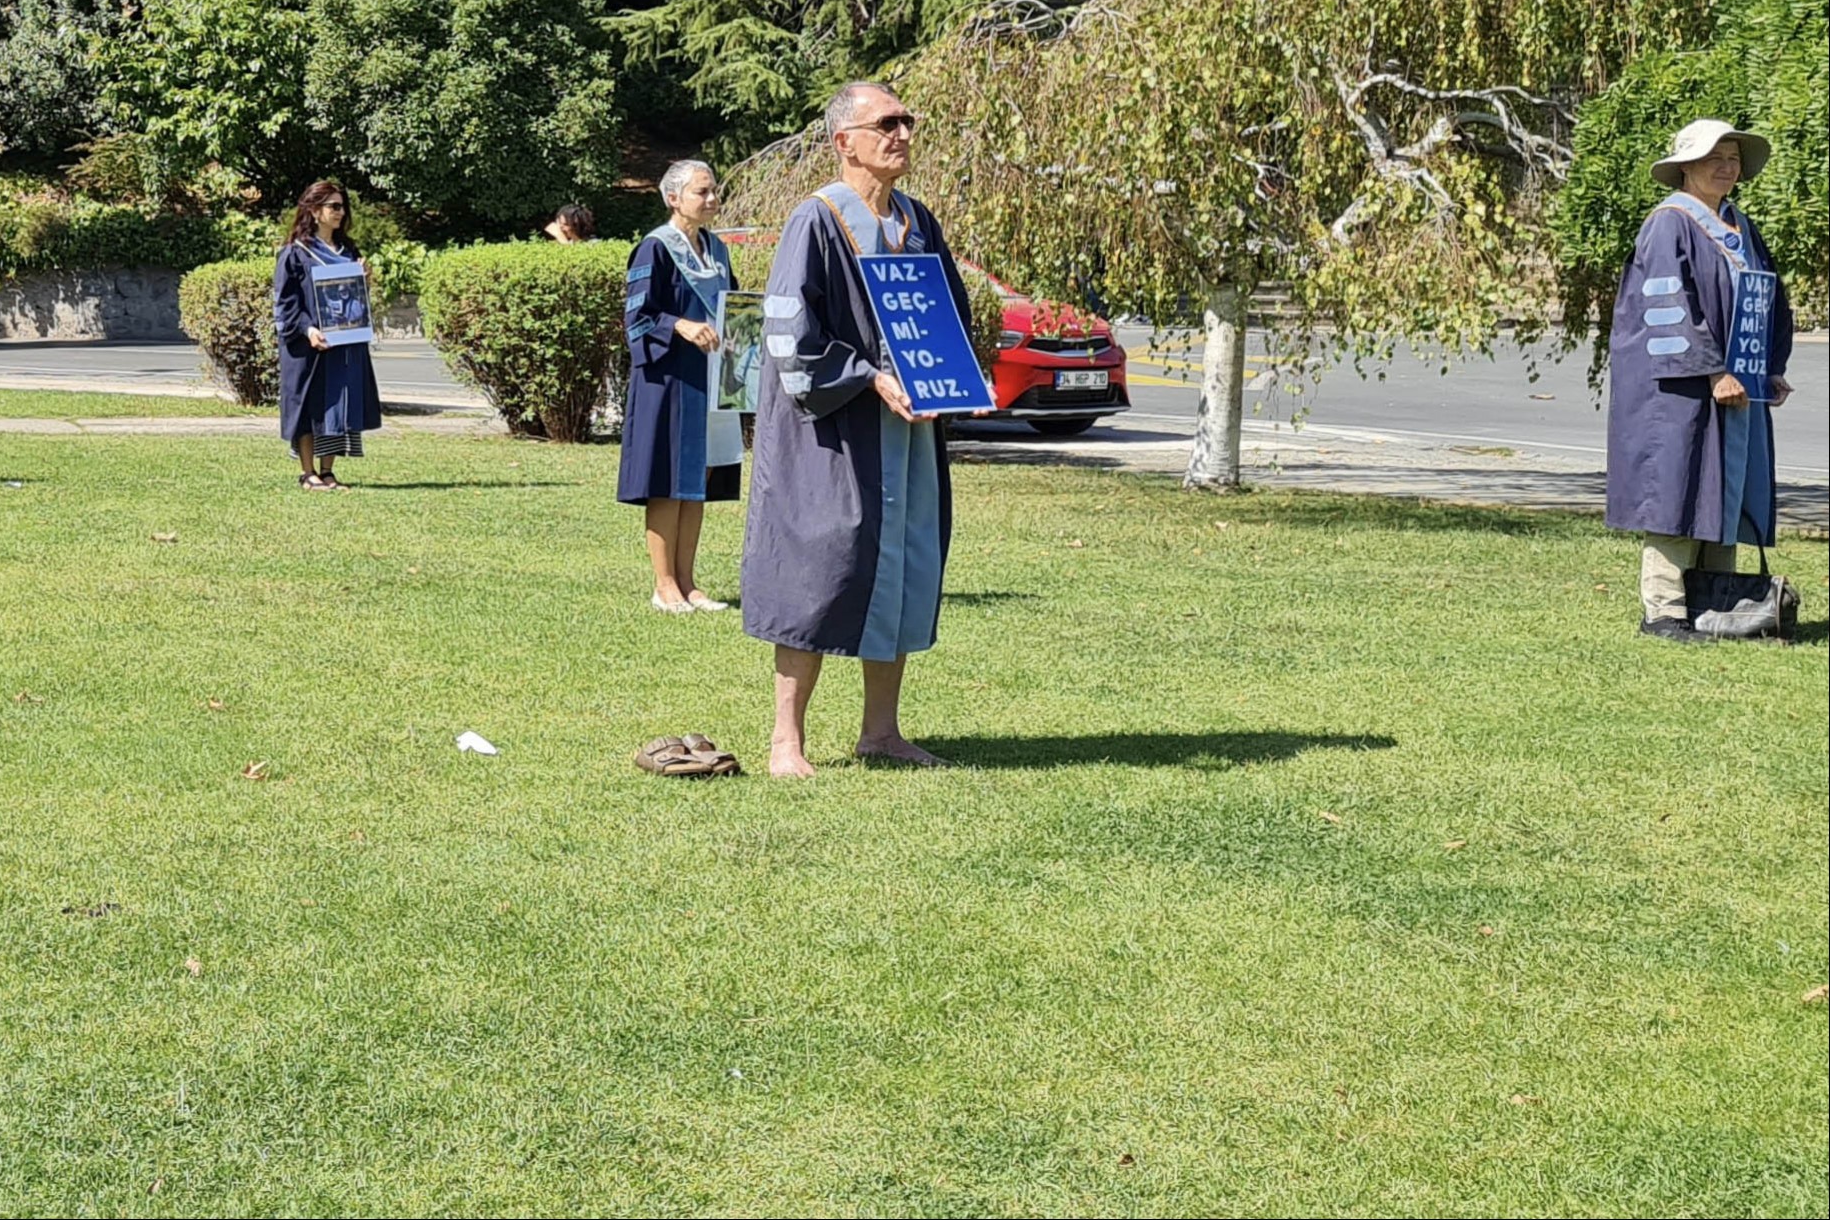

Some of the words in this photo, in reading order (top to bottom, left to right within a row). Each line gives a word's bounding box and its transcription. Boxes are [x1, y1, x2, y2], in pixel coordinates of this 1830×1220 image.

[871, 262, 927, 282] VAZ-
[881, 291, 937, 314] GEÇ-
[890, 315, 929, 341] Mİ-
[1740, 313, 1764, 333] Mİ-
[1738, 336, 1766, 355] YO-
[901, 349, 944, 369] YO-
[913, 378, 969, 400] RUZ.
